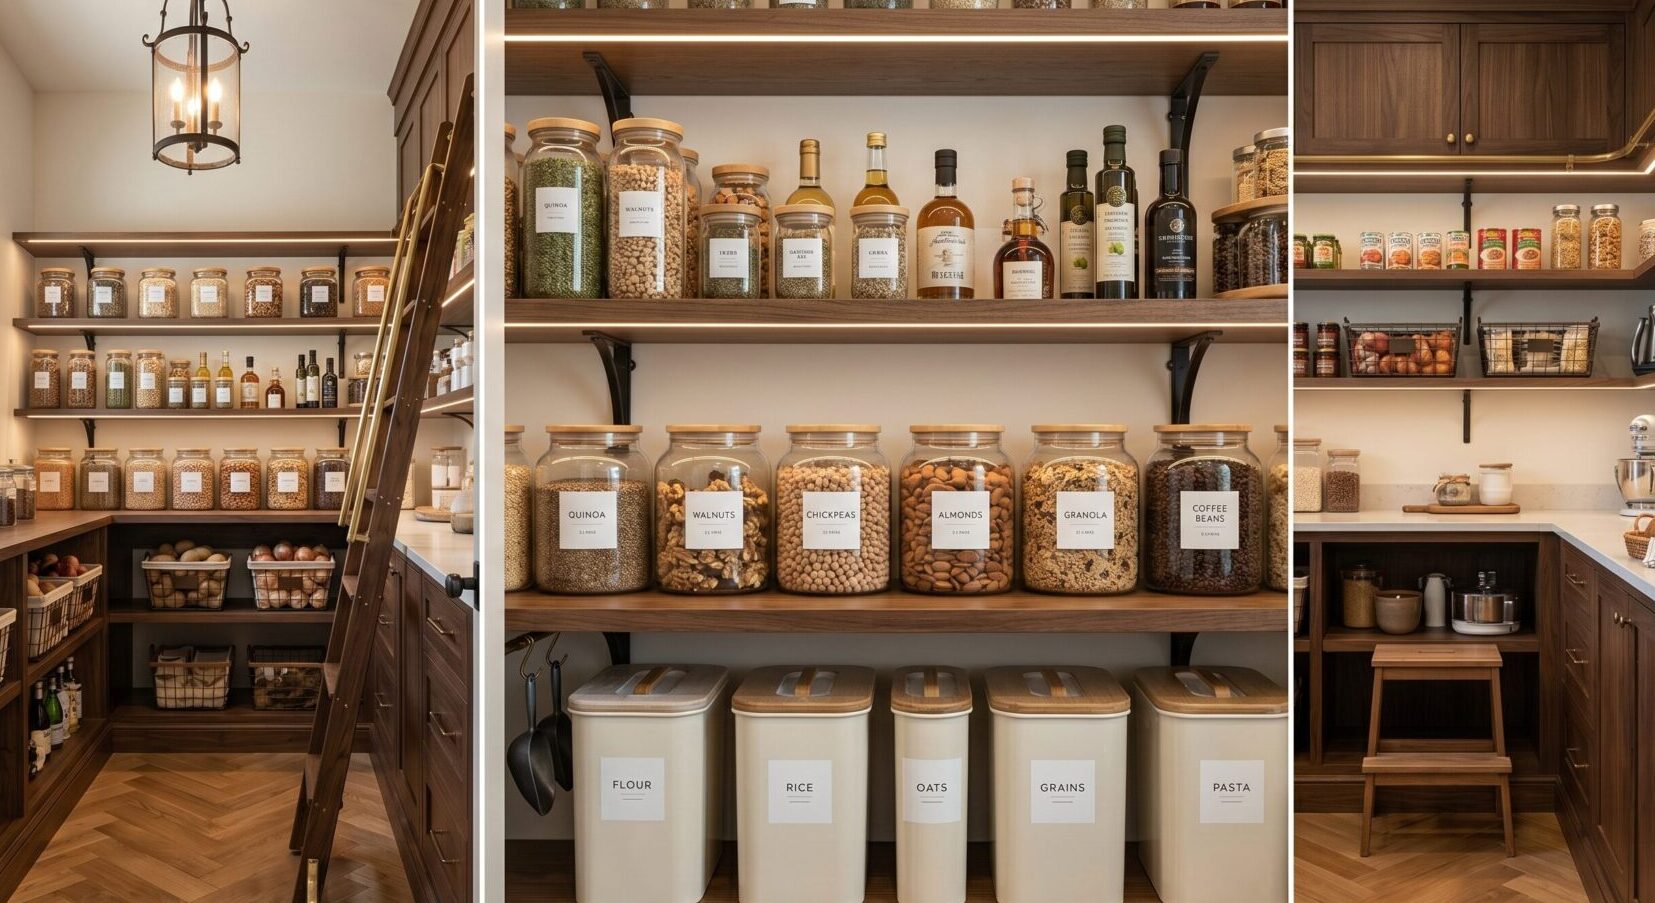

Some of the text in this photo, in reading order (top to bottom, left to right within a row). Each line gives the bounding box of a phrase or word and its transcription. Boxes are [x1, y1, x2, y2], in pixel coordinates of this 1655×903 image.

[1192, 504, 1228, 513] COFFEE
[568, 510, 606, 520] QUINOA
[692, 511, 736, 519] WALNUTS
[806, 510, 856, 519] CHICKPEAS
[938, 511, 983, 519] ALMONDS
[1063, 511, 1108, 519] GRANOLA
[1195, 515, 1225, 523] BEANS
[612, 780, 652, 790] FLOUR
[786, 782, 814, 793] RICE
[916, 782, 948, 793] OATS
[1040, 783, 1085, 793] GRAINS
[1213, 782, 1251, 793] PASTA
